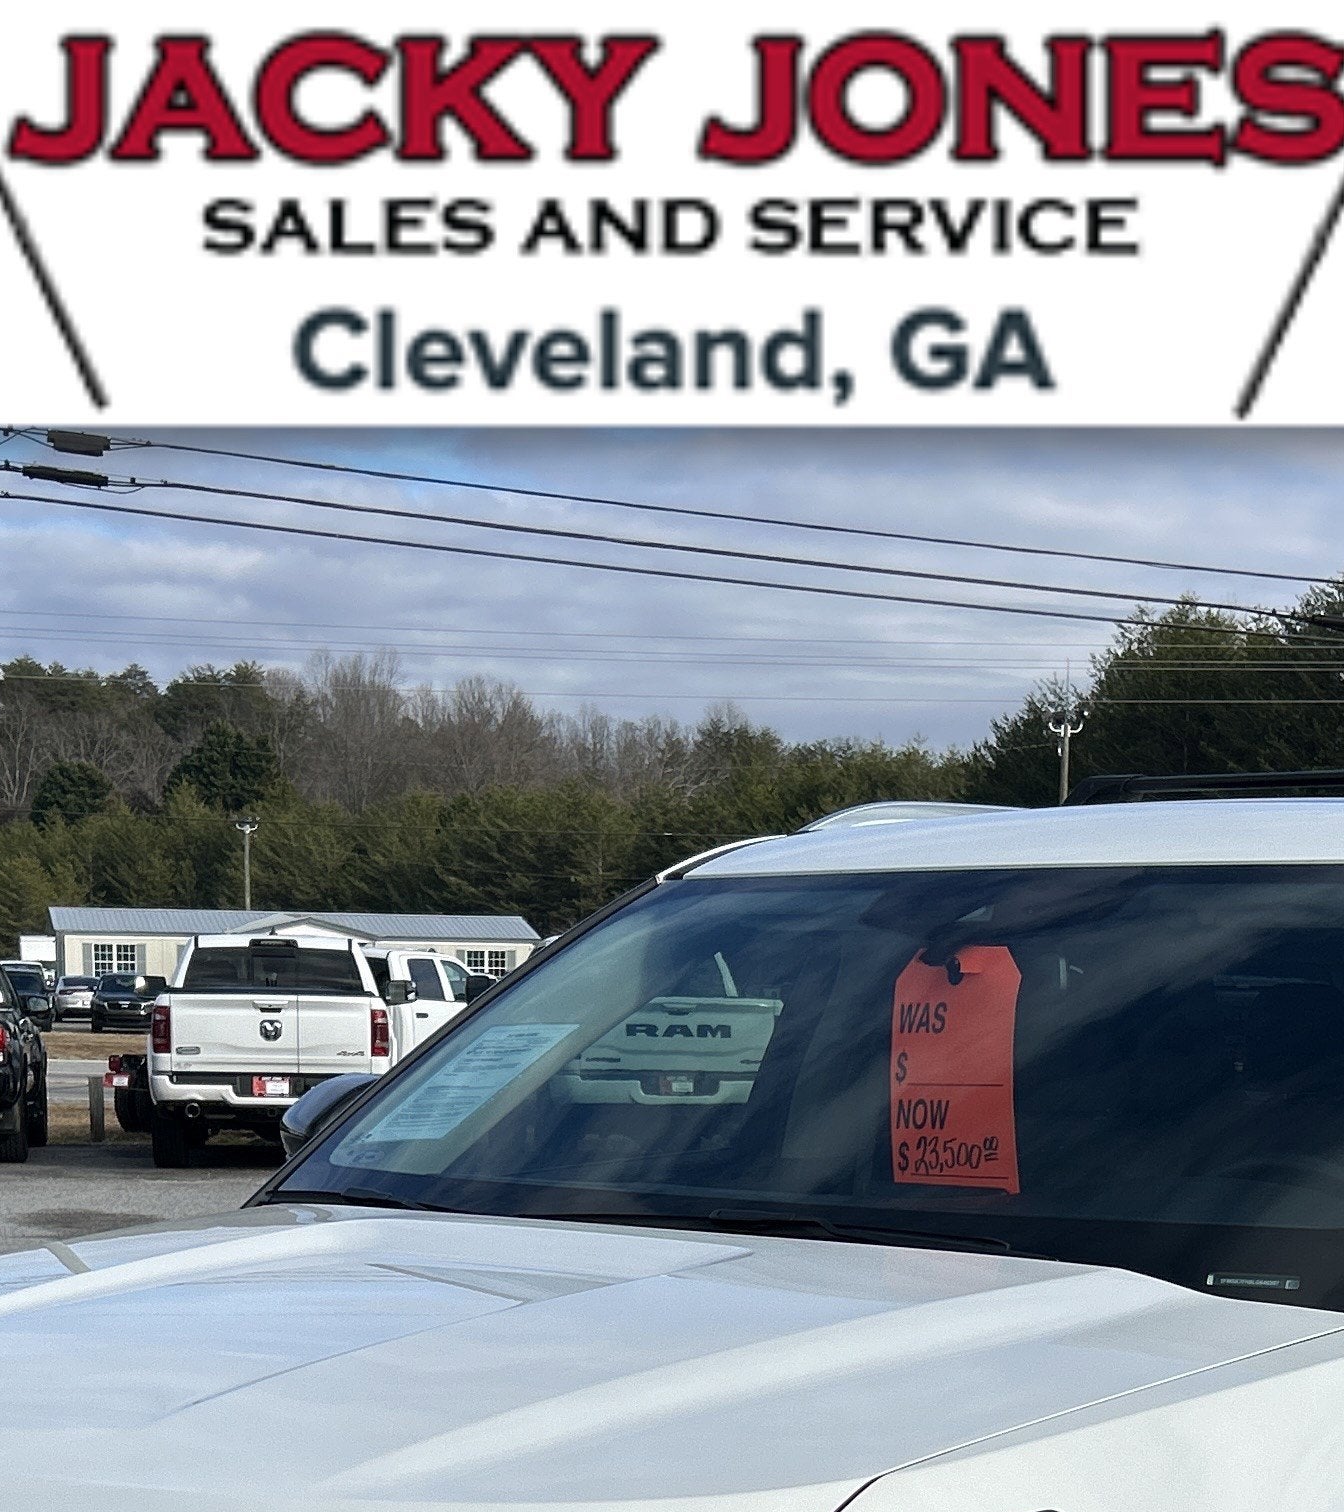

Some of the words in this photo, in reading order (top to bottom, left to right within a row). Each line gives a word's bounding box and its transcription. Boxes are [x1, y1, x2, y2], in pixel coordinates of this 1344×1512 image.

[626, 1024, 732, 1039] RAM
[900, 1002, 948, 1034] WAS
[896, 1098, 949, 1130] NOW
